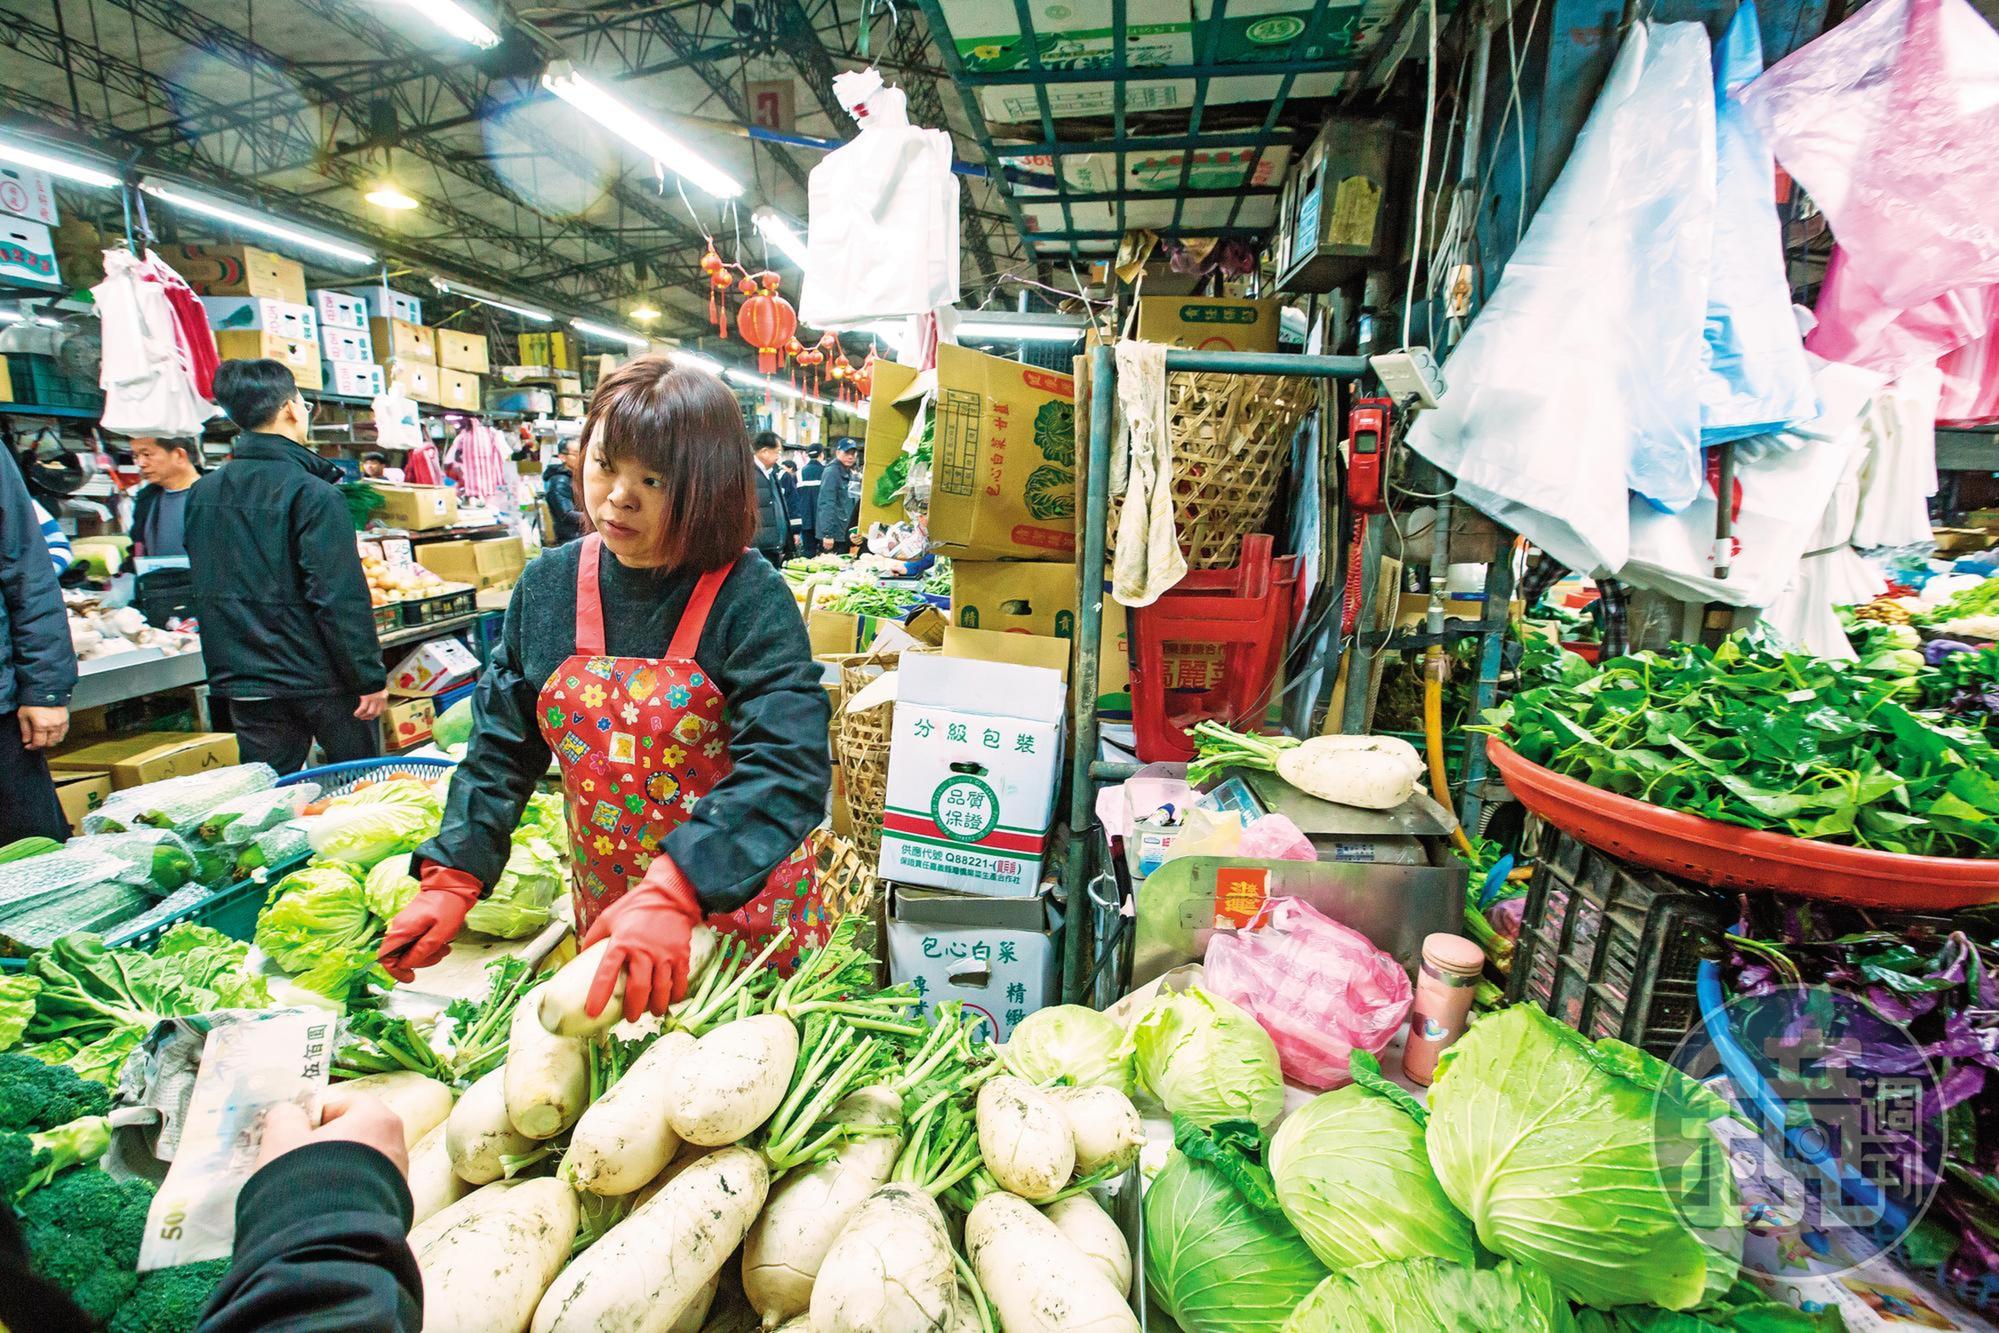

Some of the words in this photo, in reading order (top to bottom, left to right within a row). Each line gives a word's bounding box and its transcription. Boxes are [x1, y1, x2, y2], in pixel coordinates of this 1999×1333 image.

[986, 437, 1008, 497] 包心白菜
[913, 718, 1036, 755] 分級包裝
[947, 789, 985, 809] 品質
[945, 810, 983, 831] 保證
[901, 844, 943, 862] 供應代號
[921, 936, 1019, 965] 包心白菜
